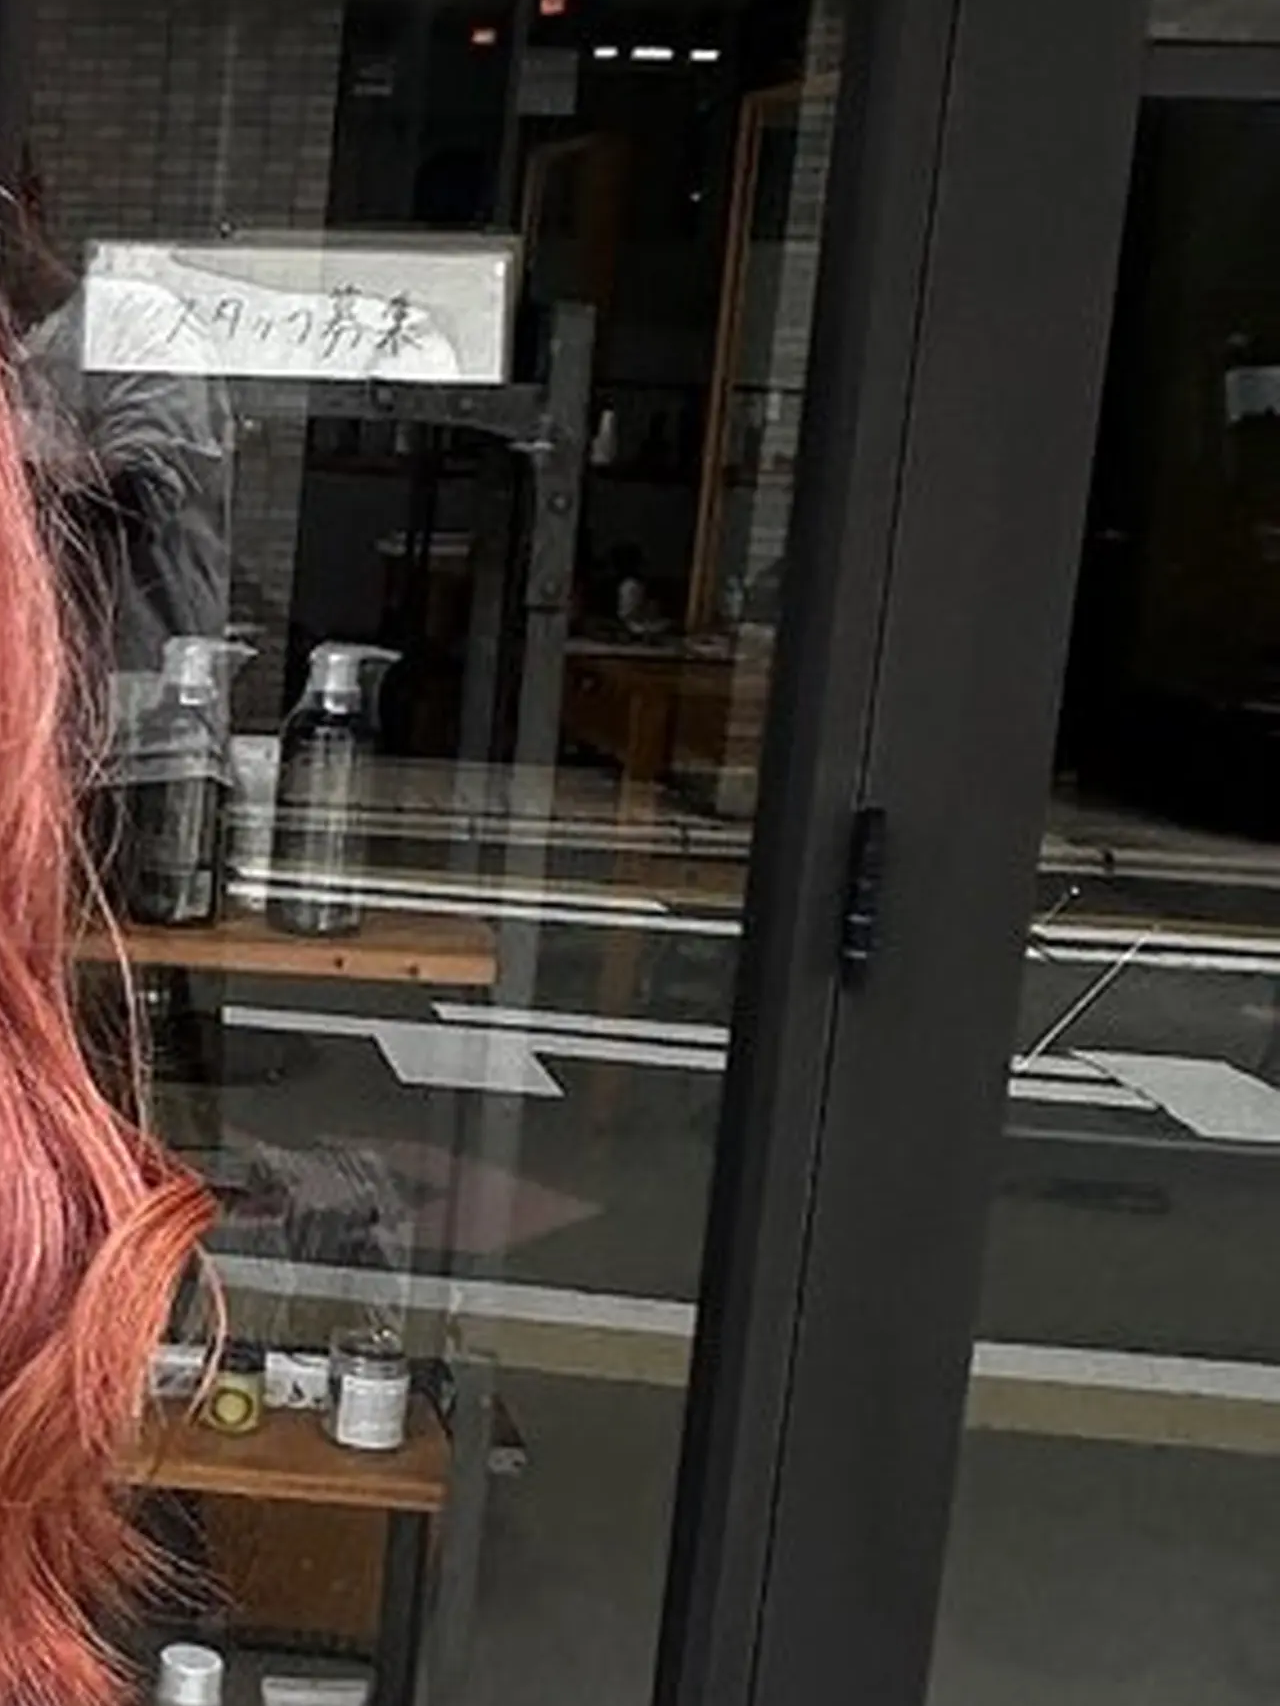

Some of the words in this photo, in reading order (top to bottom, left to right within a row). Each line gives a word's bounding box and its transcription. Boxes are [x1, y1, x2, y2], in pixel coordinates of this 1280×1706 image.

[165, 284, 424, 358] スタッフ募集
